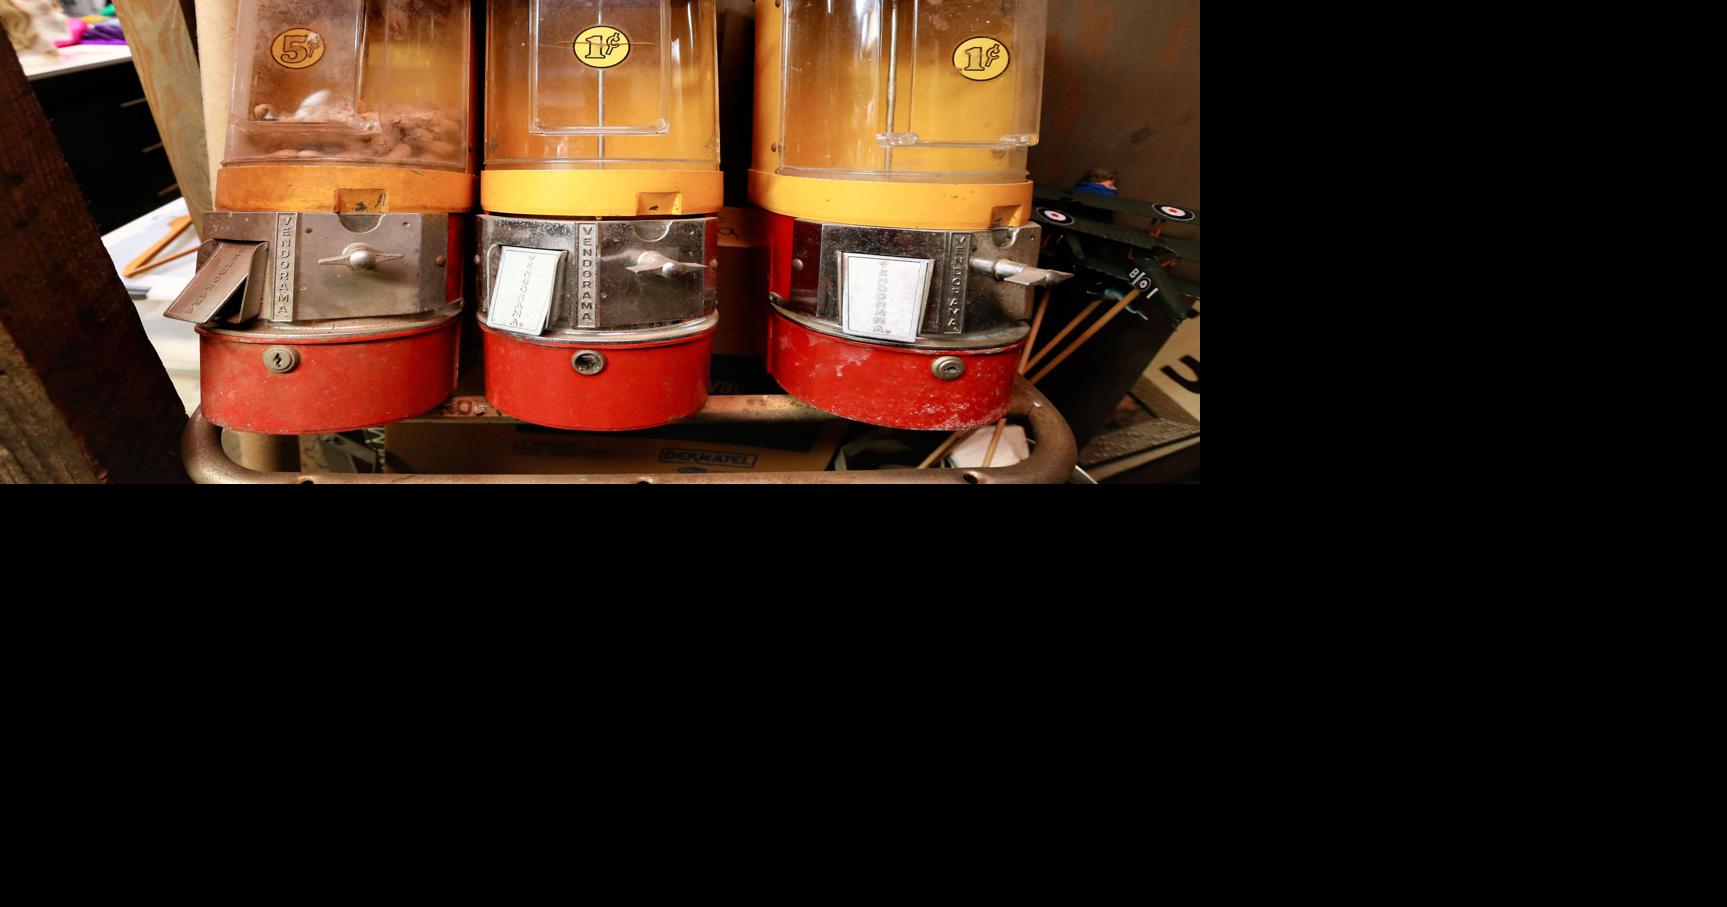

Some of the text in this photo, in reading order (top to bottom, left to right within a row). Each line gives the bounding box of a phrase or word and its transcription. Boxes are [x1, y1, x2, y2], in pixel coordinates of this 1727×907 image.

[585, 32, 620, 59] 1¢
[964, 43, 1000, 71] 1¢
[277, 215, 293, 315] VENDORAMA
[580, 225, 594, 321] VENDORAMA
